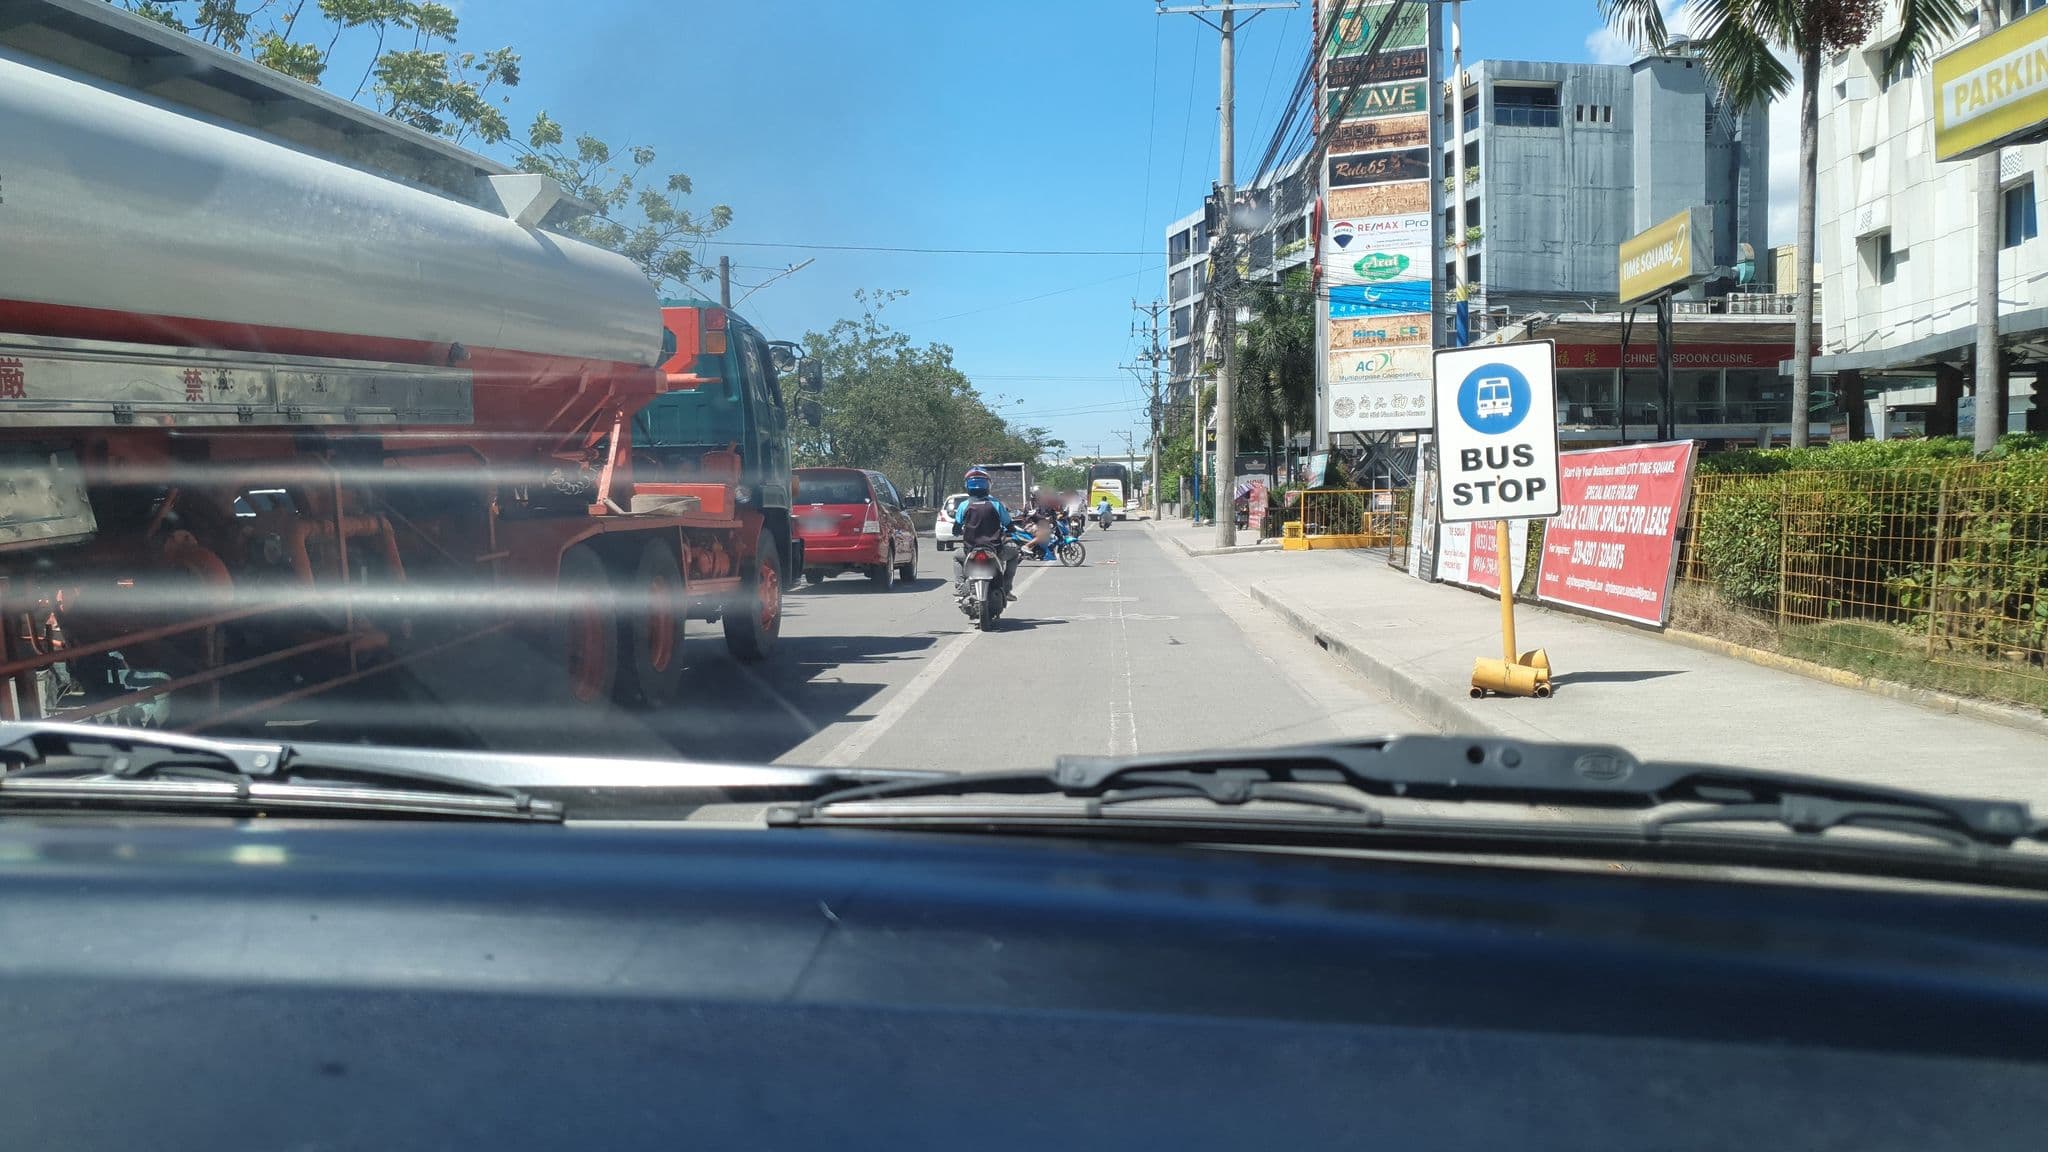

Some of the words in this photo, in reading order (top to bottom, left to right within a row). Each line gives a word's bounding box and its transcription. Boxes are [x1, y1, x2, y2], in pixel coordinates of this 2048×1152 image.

[1365, 85, 1416, 109] AVE
[1357, 221, 1399, 232] RE/MAX
[1405, 219, 1429, 228] Pro
[1623, 256, 1640, 280] TIME
[1640, 240, 1674, 272] SQUARE
[1352, 329, 1386, 340] King
[1672, 353, 1710, 363] SPOON
[1711, 353, 1754, 364] CUISINE
[1461, 444, 1535, 472] BUS
[1626, 462, 1639, 475] CITY
[1652, 460, 1676, 476] SQUARE
[1452, 477, 1546, 506] STOP
[1579, 505, 1603, 532] CLINIC
[1600, 505, 1631, 534] SPACES
[1627, 505, 1646, 535] FOR
[1643, 506, 1672, 536] LEASE
